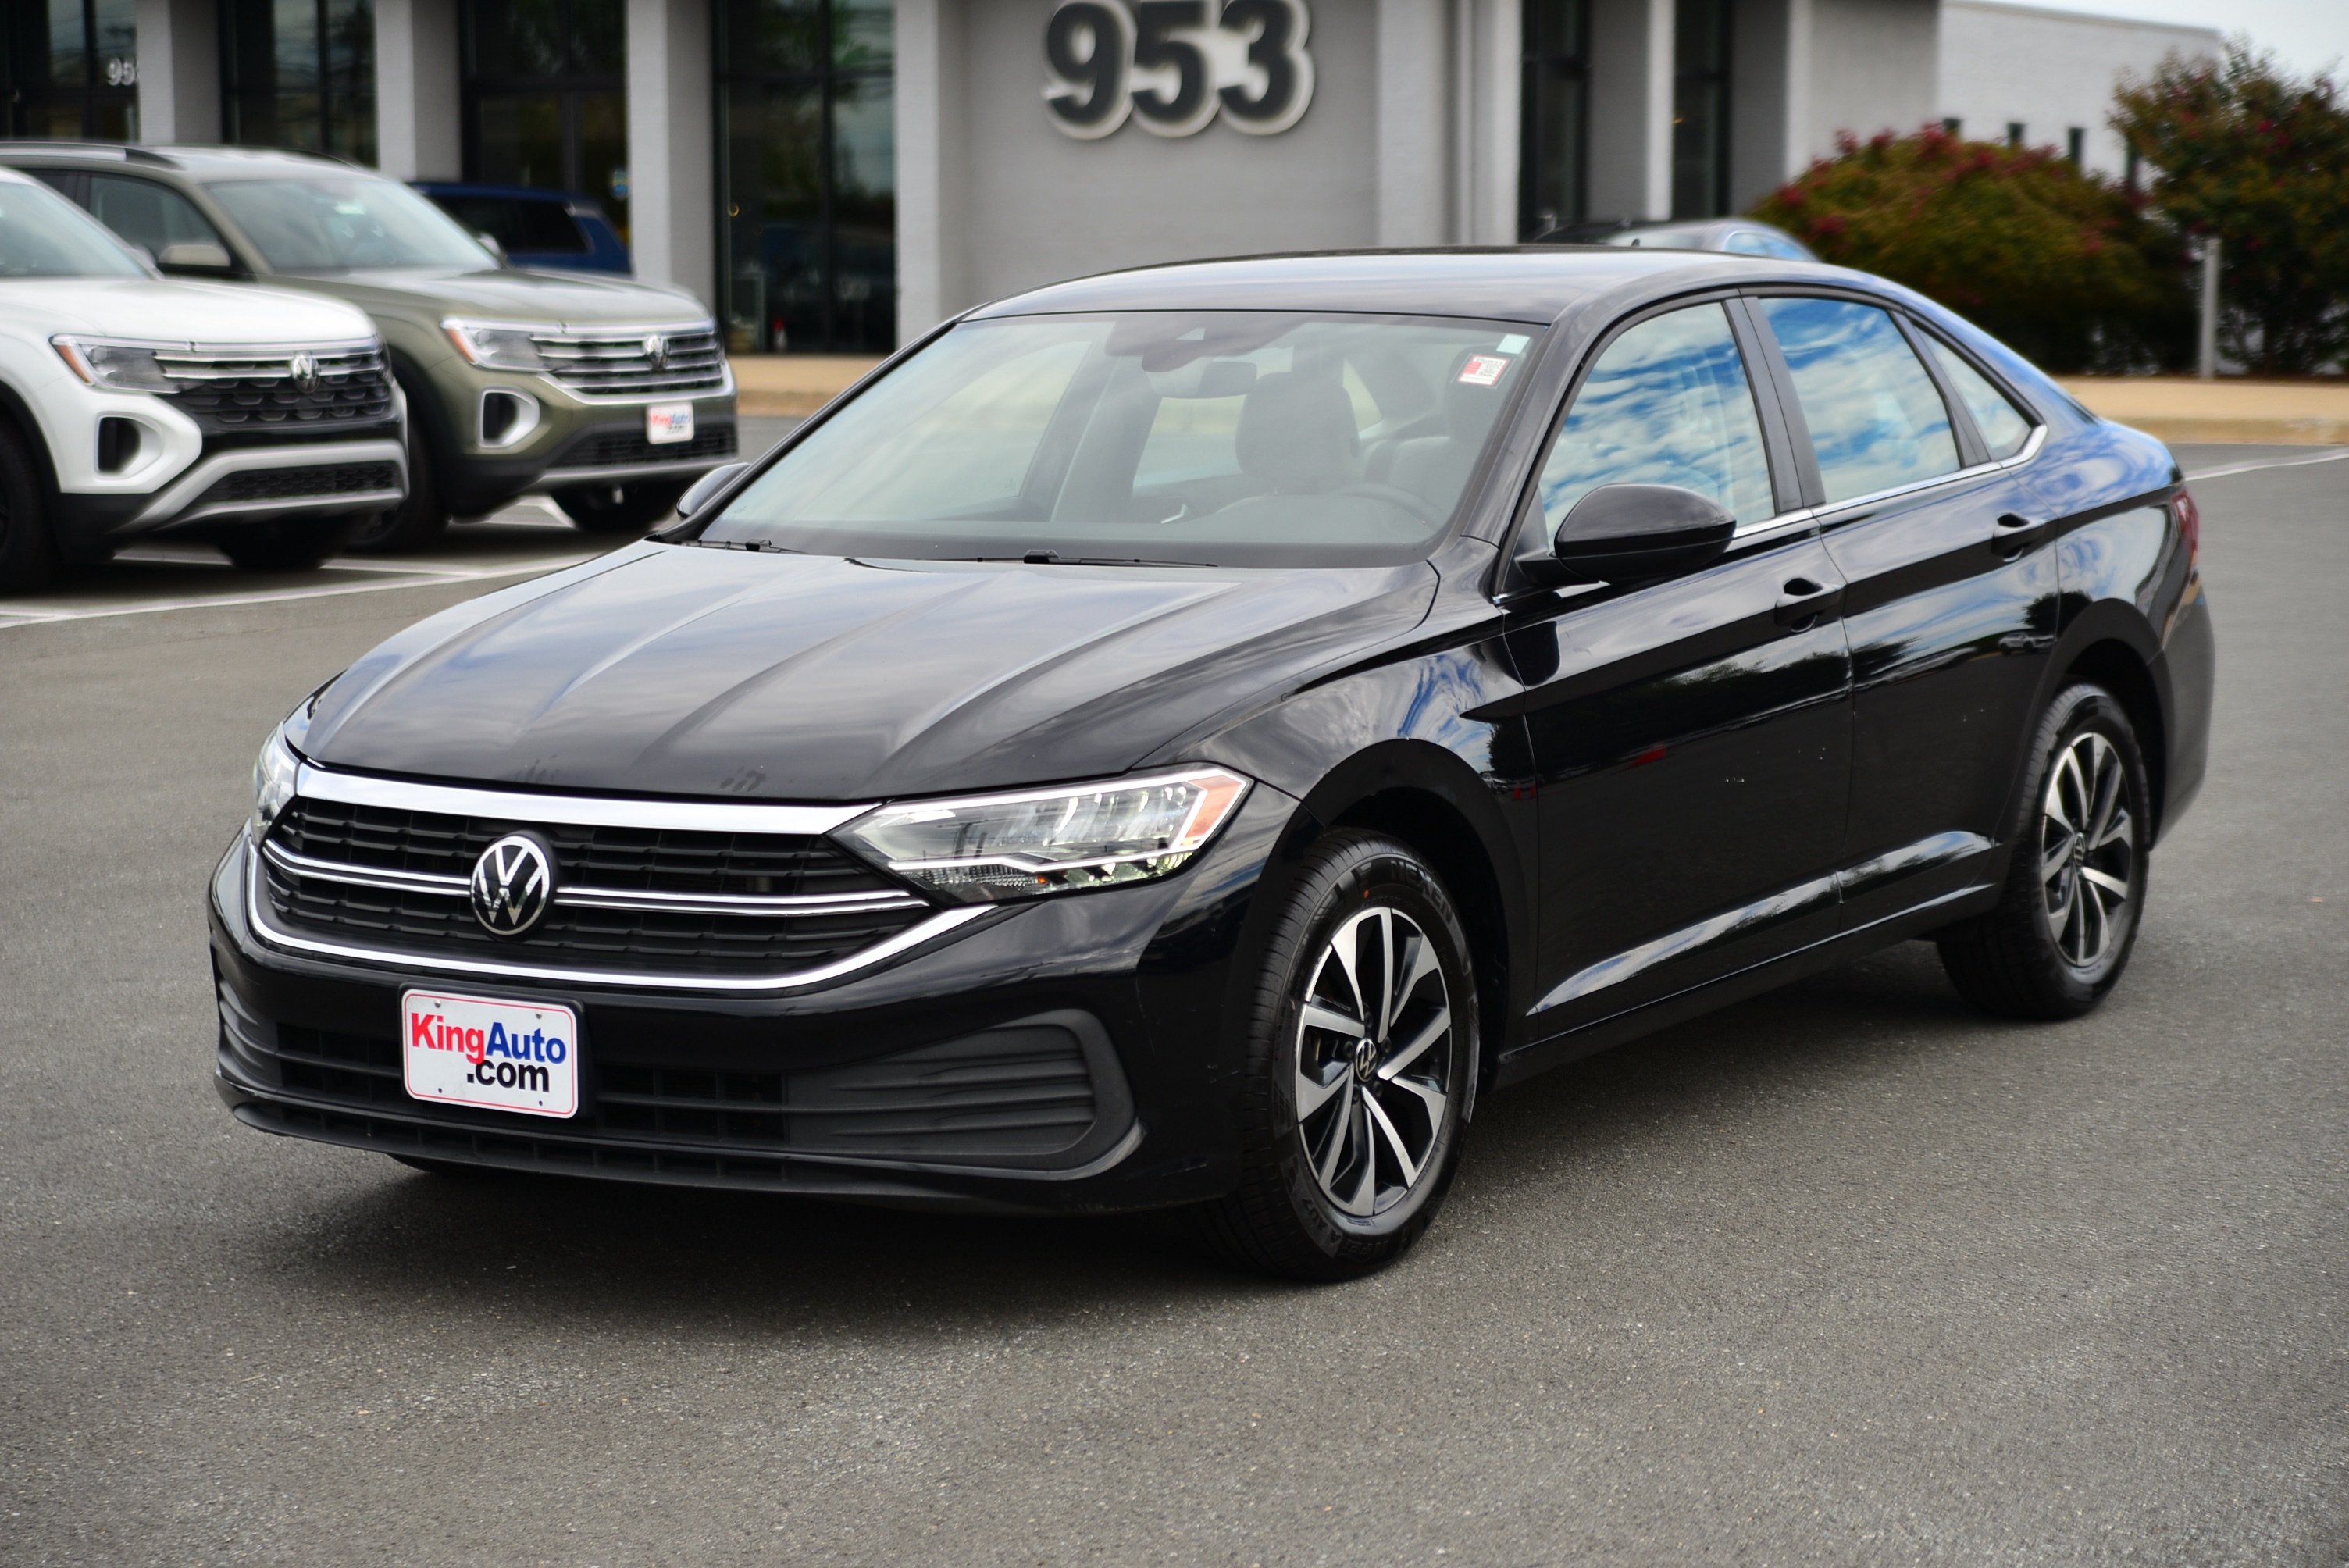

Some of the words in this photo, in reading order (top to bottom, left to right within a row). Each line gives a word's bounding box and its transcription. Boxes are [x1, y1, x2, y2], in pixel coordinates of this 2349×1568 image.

[107, 57, 140, 86] 95
[1045, 0, 1304, 131] 953
[472, 837, 548, 931] VW
[1389, 860, 1453, 925] NEXEN
[412, 1013, 567, 1064] KingAuto
[466, 1060, 550, 1092] .com
